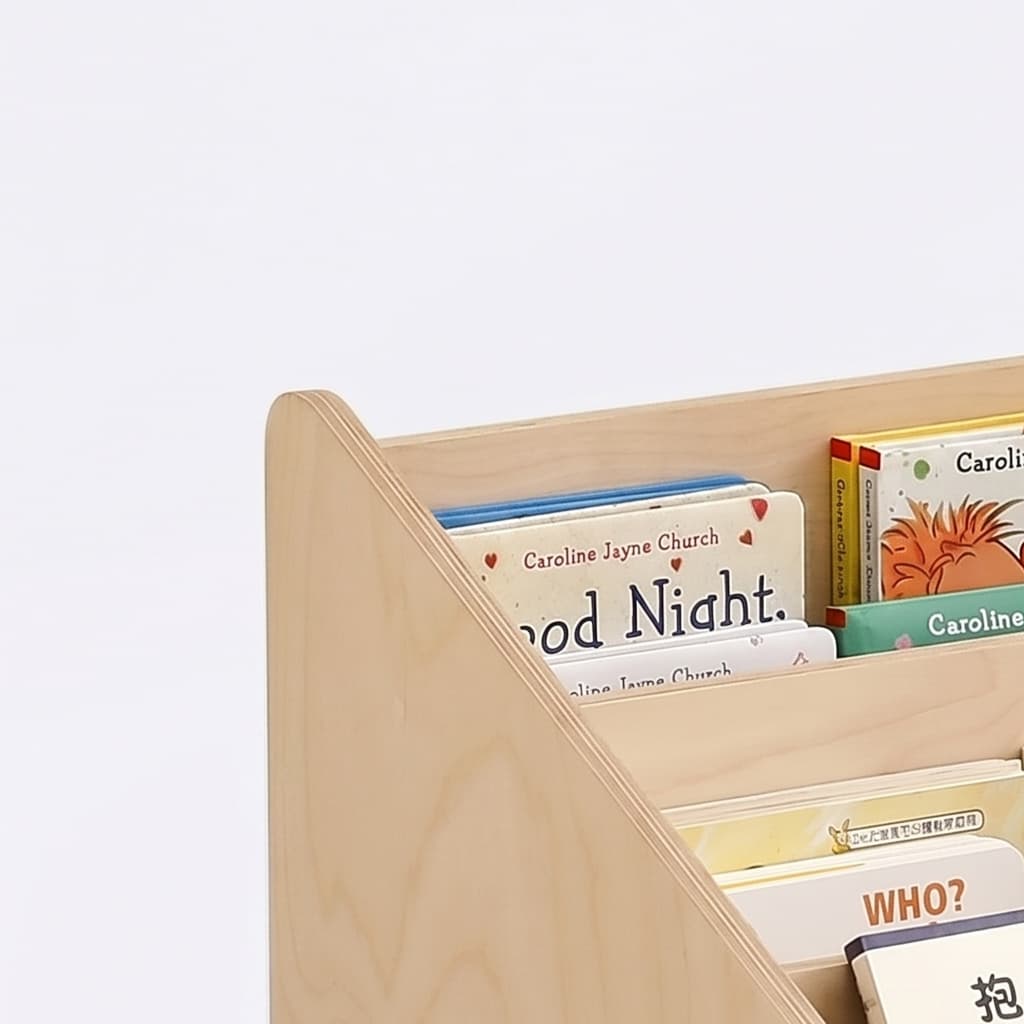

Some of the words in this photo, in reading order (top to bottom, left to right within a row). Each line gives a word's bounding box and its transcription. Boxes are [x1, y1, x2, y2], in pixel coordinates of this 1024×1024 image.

[524, 547, 597, 569] Caroline
[603, 541, 651, 562] Jayne
[658, 527, 719, 551] Church
[928, 608, 1024, 636] Caroline
[862, 878, 966, 927] WHO?
